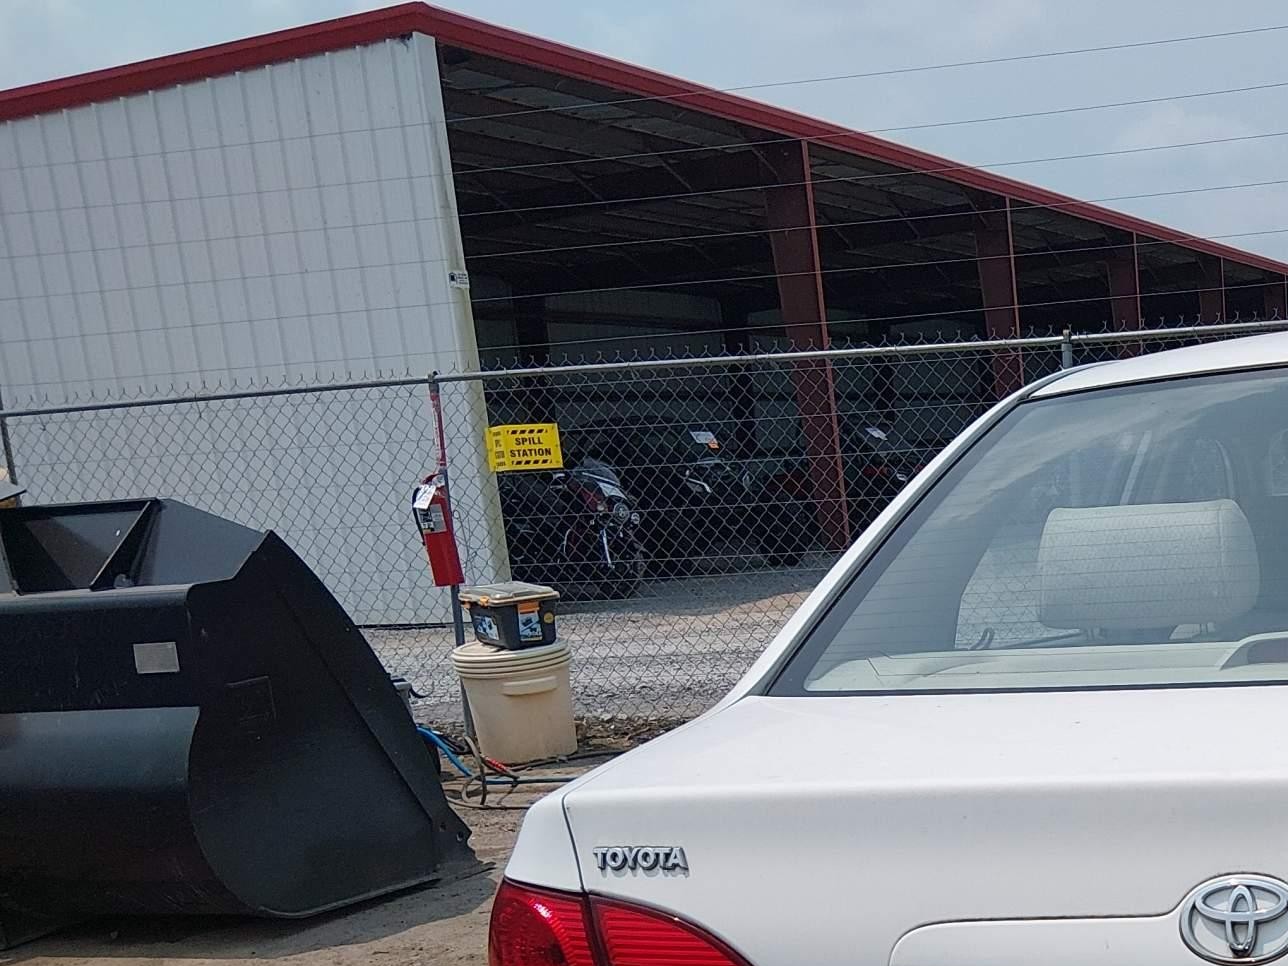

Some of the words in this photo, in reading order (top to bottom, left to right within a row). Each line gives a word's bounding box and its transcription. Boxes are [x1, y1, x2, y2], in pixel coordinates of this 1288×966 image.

[515, 437, 543, 446] SPILL
[510, 448, 552, 458] STATION
[593, 846, 689, 871] TOYOTA
